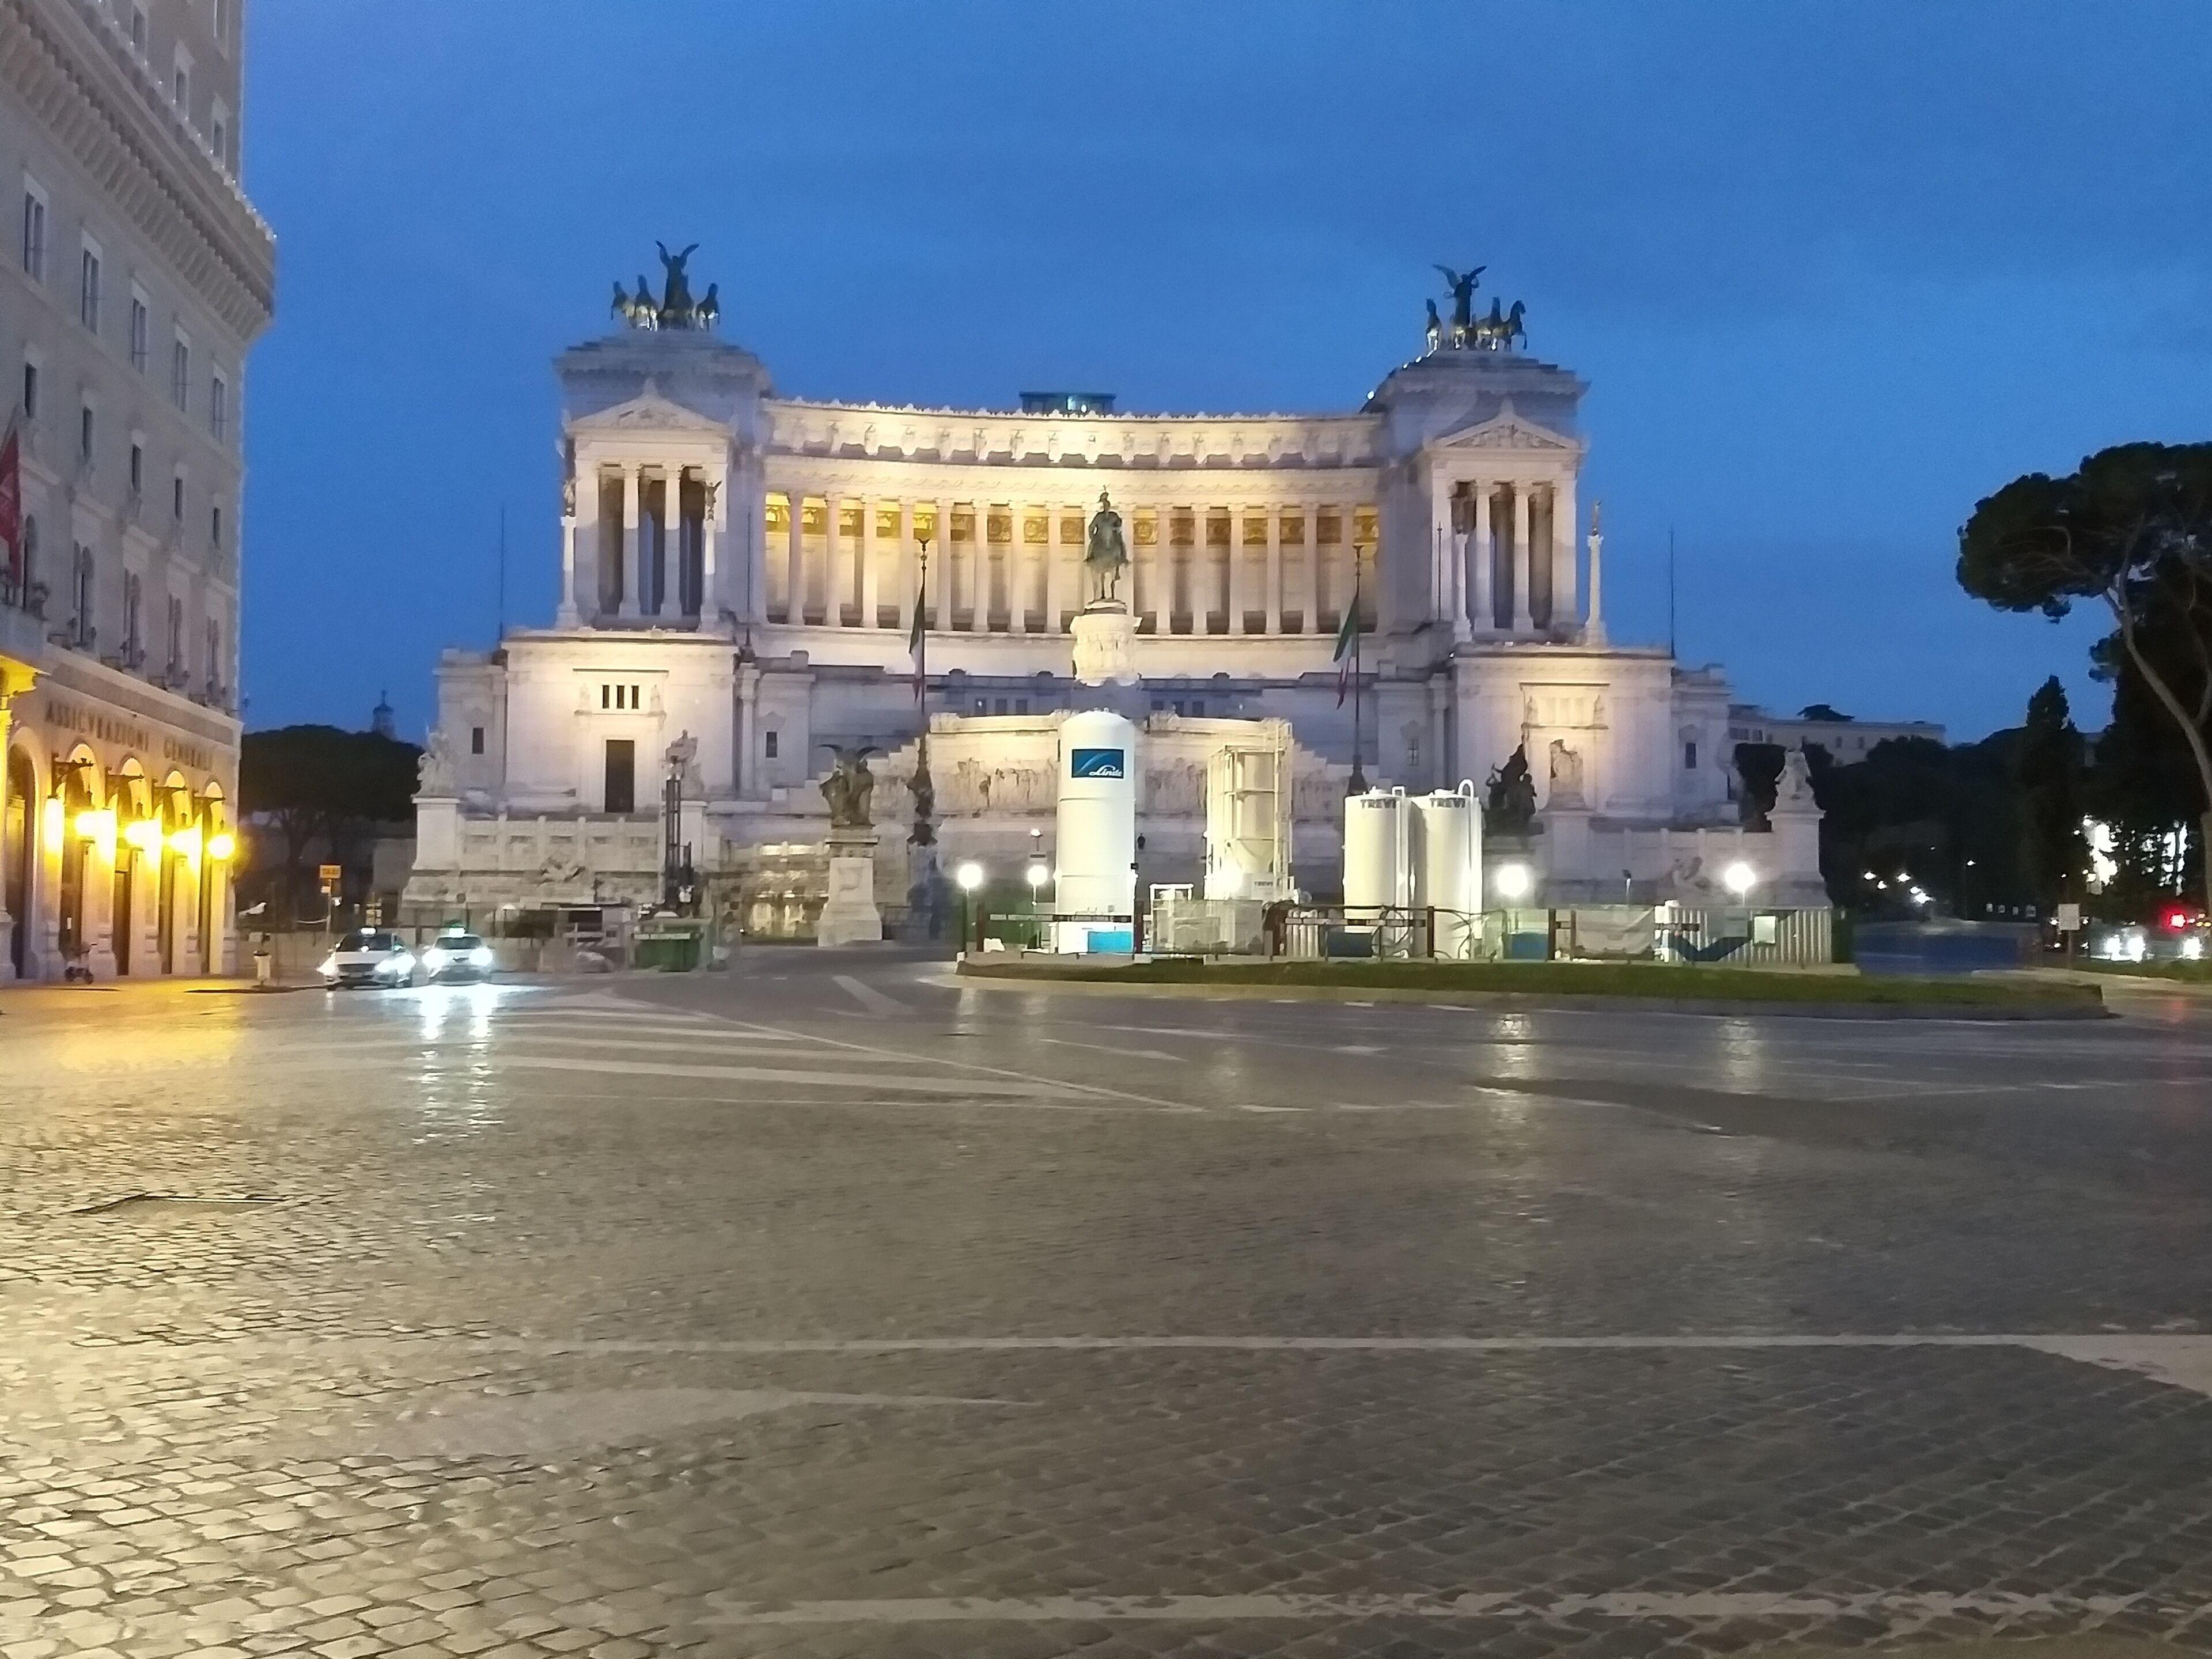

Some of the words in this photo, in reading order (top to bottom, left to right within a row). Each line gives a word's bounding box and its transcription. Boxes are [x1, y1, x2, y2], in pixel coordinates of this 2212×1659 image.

[1089, 765, 1123, 776] Linde
[1360, 798, 1396, 809] TREVI
[1429, 797, 1465, 808] TREVI
